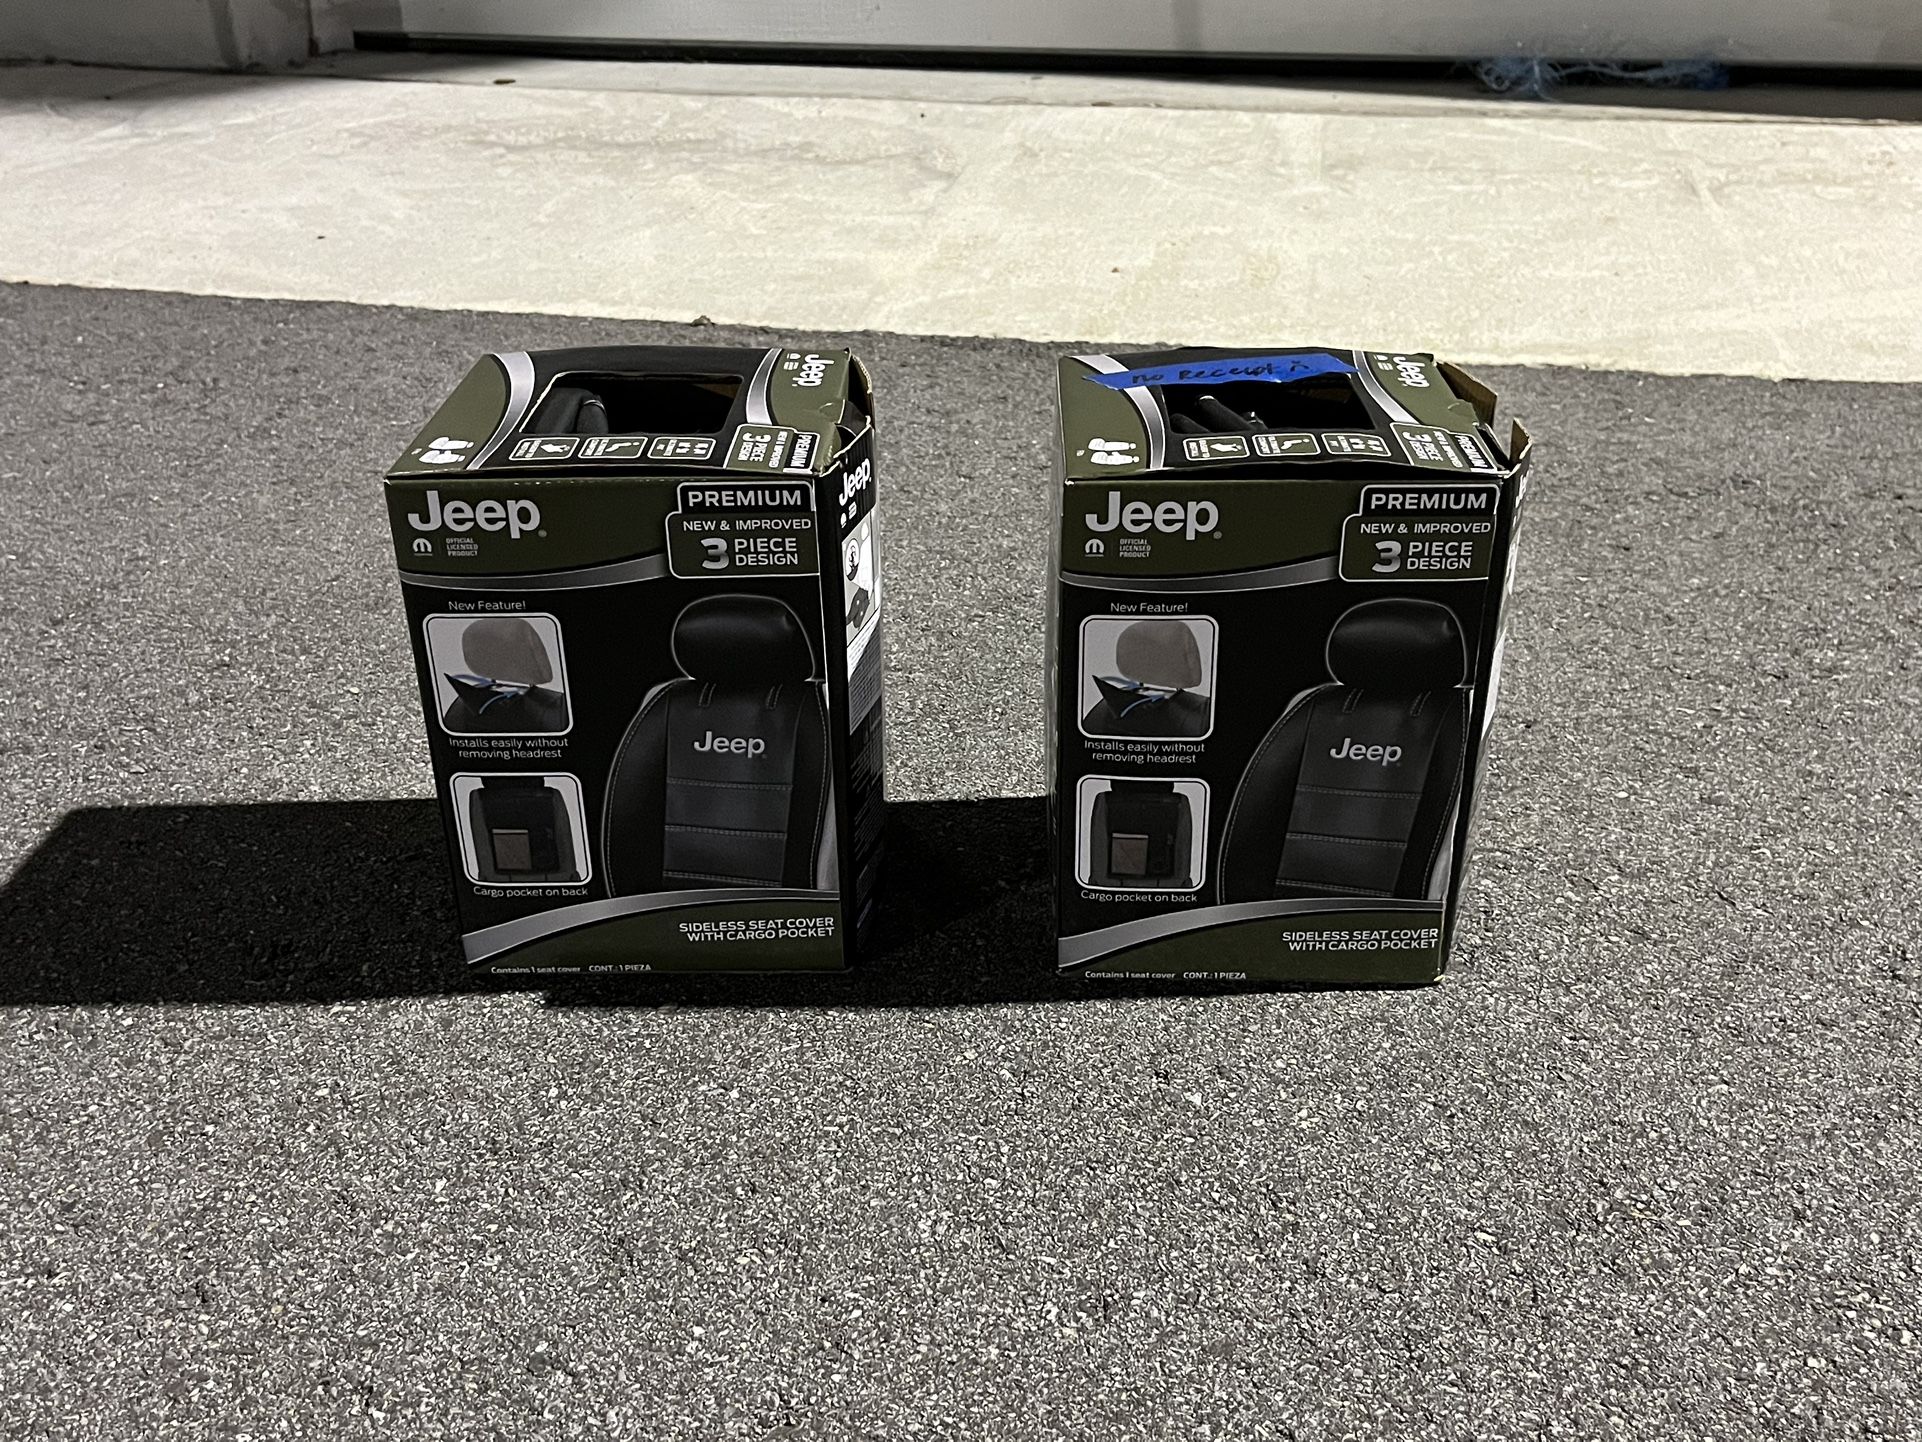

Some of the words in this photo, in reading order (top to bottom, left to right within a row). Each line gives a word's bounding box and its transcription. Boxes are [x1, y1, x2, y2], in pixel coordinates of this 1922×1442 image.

[792, 354, 835, 387] Jeep
[1393, 356, 1430, 388] Jeep
[1131, 373, 1164, 385] no
[742, 432, 772, 443] 3
[750, 442, 768, 462] PIECE
[790, 434, 812, 468] PREMIUM
[1402, 431, 1432, 442] 3
[1422, 442, 1444, 462] PIECE
[1454, 435, 1488, 468] PREMIUM
[839, 458, 871, 507] Jeep
[688, 489, 802, 507] PREMIUM
[1370, 493, 1487, 510] PREMIUM
[407, 490, 541, 539] Jeep
[1085, 490, 1219, 541] Jeep
[683, 520, 717, 531] NEW
[719, 520, 731, 531] &
[735, 519, 812, 531] IMPROVED
[1360, 523, 1395, 534] NEW
[1397, 523, 1408, 534] &
[1414, 522, 1491, 534] IMPROVED
[700, 537, 730, 570] 3
[734, 537, 798, 553] PIECE
[735, 553, 799, 567] DESIGN
[1371, 540, 1402, 573] 3
[1408, 541, 1473, 556] PIECE
[1406, 557, 1472, 570] DESIGN
[448, 601, 476, 611] New
[478, 600, 526, 611] Feature!
[1110, 602, 1138, 613] New
[1139, 602, 1188, 613] Feature!
[449, 738, 490, 748] Installs
[491, 738, 523, 749] easily
[525, 737, 569, 748] without
[693, 730, 766, 759] Jeep
[1084, 739, 1125, 751] Installs
[1127, 741, 1159, 753] easily
[1161, 743, 1205, 753] without
[458, 750, 511, 760] removing
[512, 748, 562, 759] headrest
[1092, 752, 1144, 764] removing
[1147, 753, 1197, 764] headrest
[1329, 737, 1402, 767] Jeep
[473, 886, 504, 898] Cargo
[506, 887, 543, 898] pocket
[545, 888, 560, 896] on
[562, 887, 588, 896] back
[1080, 889, 1113, 902] Cargo
[1114, 893, 1152, 904] pocket
[1154, 894, 1169, 902] on
[1171, 893, 1198, 902] back
[679, 921, 746, 933] SIDELESS
[748, 919, 784, 931] SEAT
[786, 917, 835, 929] COVER
[686, 931, 724, 942] WITH
[726, 929, 776, 941] CARGO
[778, 926, 835, 938] POCKET
[1282, 931, 1350, 942] SIDELESS
[1352, 930, 1389, 940] SEAT
[1391, 928, 1439, 939] COVER
[1288, 941, 1326, 952] WITH
[1328, 940, 1379, 951] CARGO
[1381, 938, 1439, 950] POCKET
[490, 966, 531, 974] Contains
[536, 966, 556, 974] seat
[625, 964, 652, 972] PIEZA
[1084, 970, 1125, 979] Contains
[1130, 971, 1150, 979] seat
[1219, 971, 1247, 980] PIEZA
